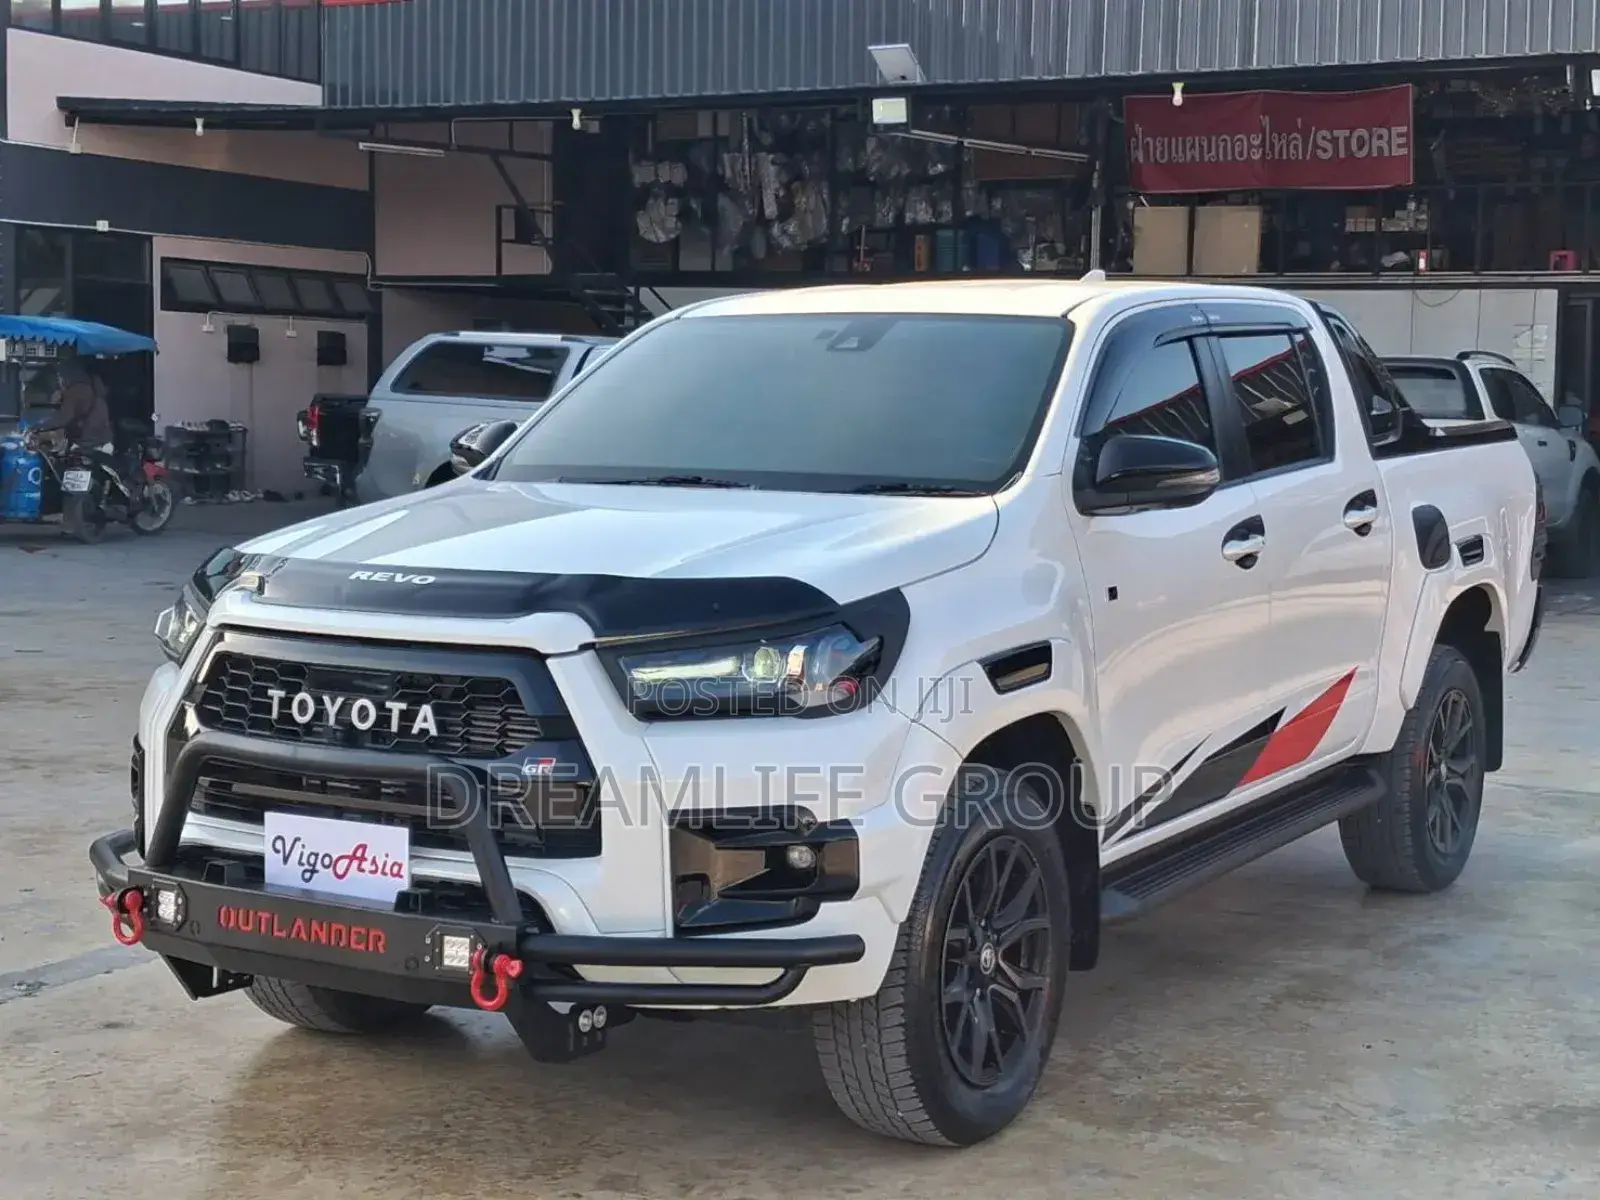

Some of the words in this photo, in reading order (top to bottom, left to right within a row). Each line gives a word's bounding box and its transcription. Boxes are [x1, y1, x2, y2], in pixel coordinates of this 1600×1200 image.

[348, 570, 437, 586] REVO
[267, 688, 439, 738] TOYOTA
[271, 834, 405, 884] VigoAsia
[217, 904, 388, 955] OUTLANDER
